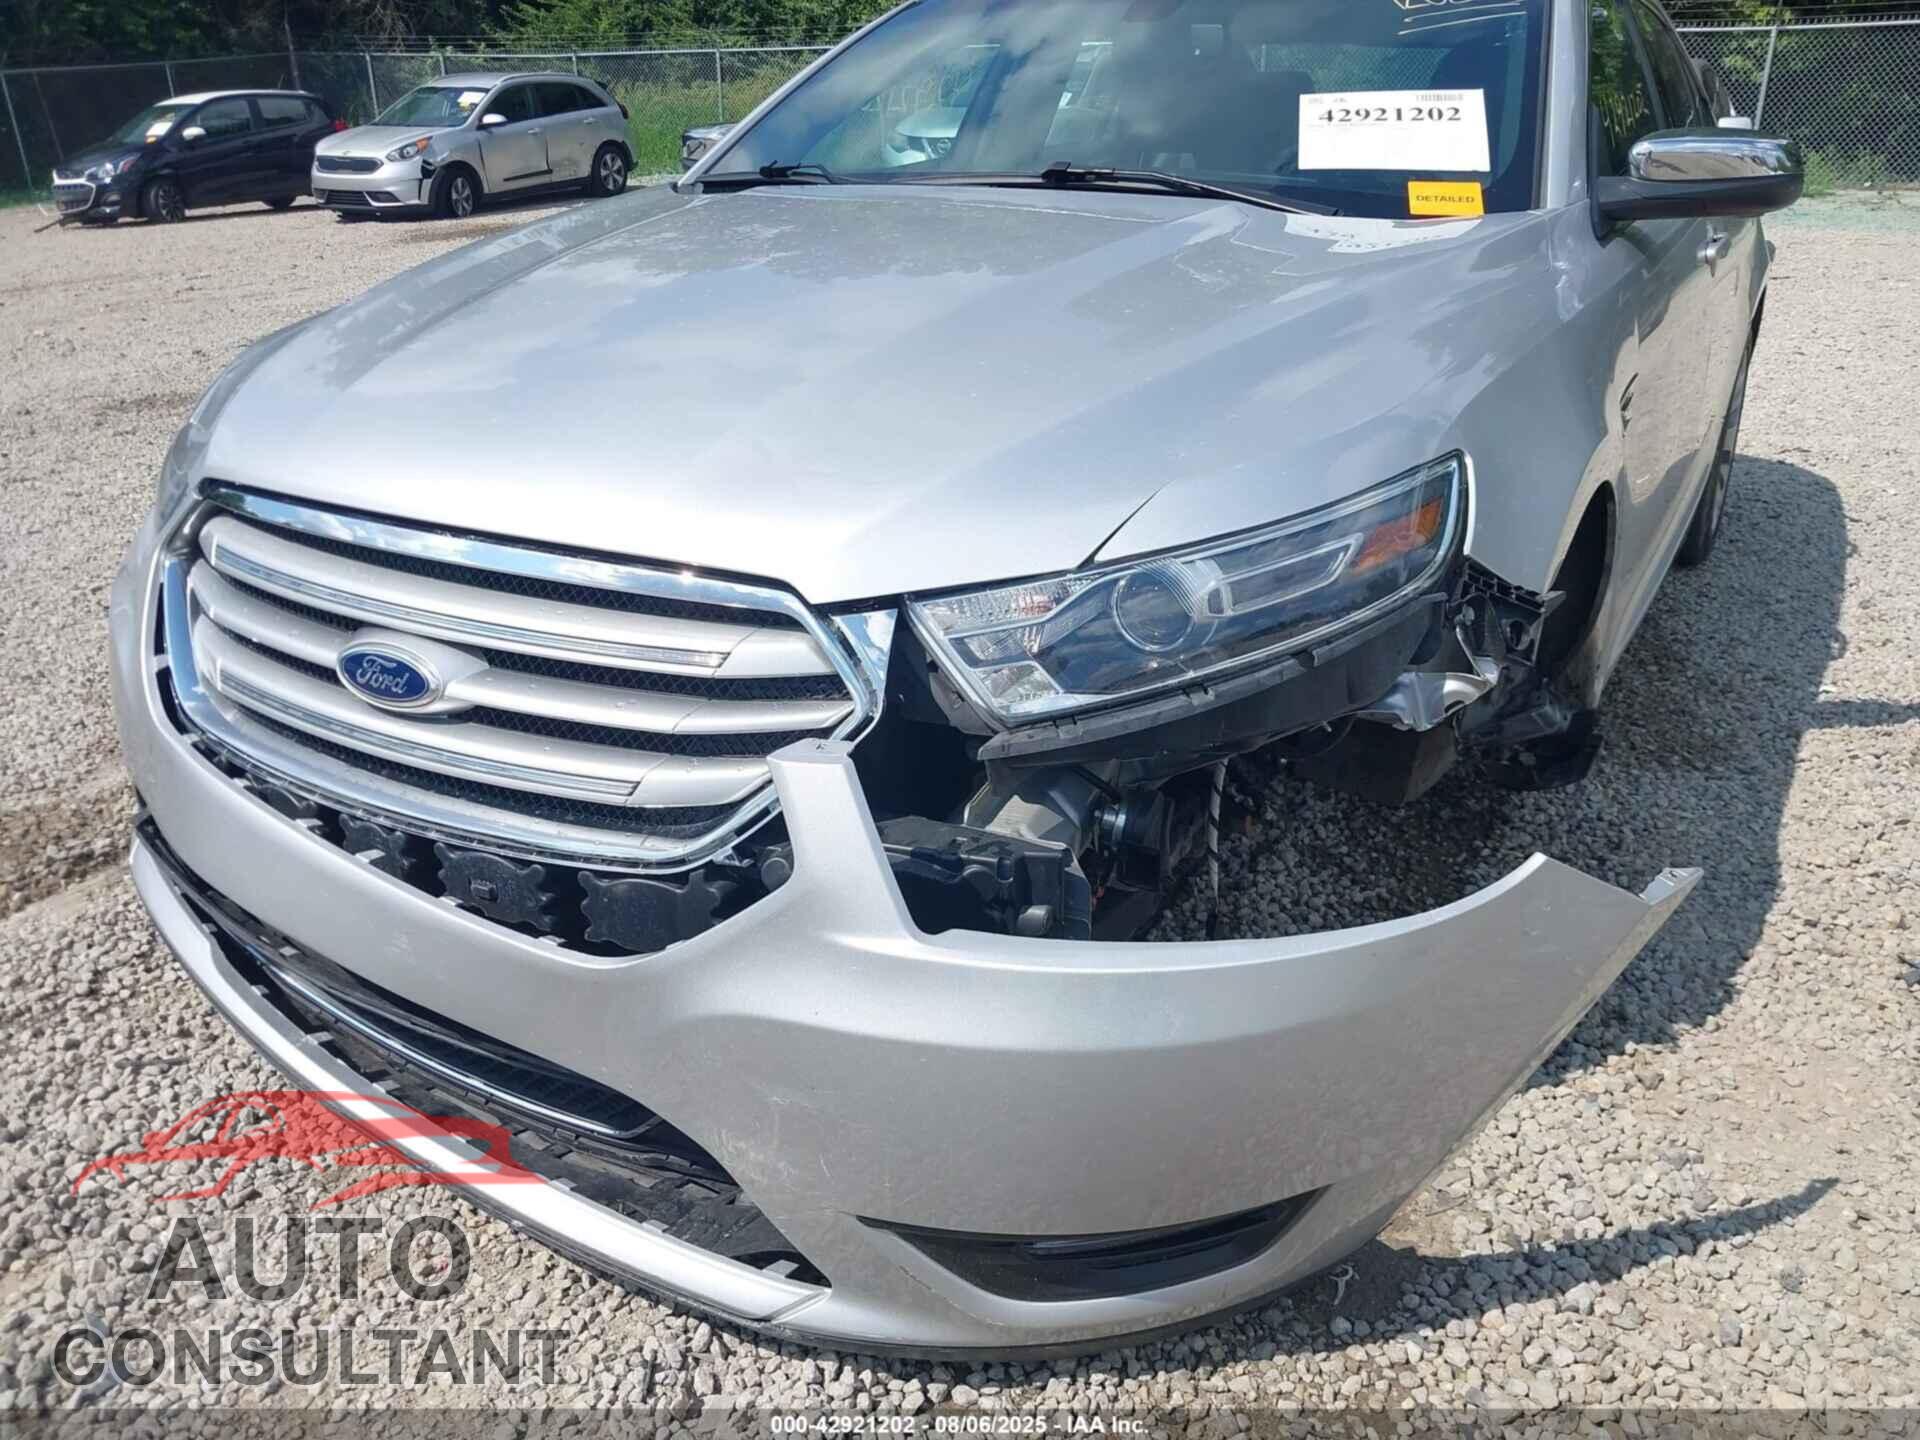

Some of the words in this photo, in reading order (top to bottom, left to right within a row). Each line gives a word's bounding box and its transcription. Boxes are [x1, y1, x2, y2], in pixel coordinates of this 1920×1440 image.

[1318, 106, 1462, 122] 42921202
[1415, 194, 1476, 204] DETAILED
[356, 655, 410, 694] Ford
